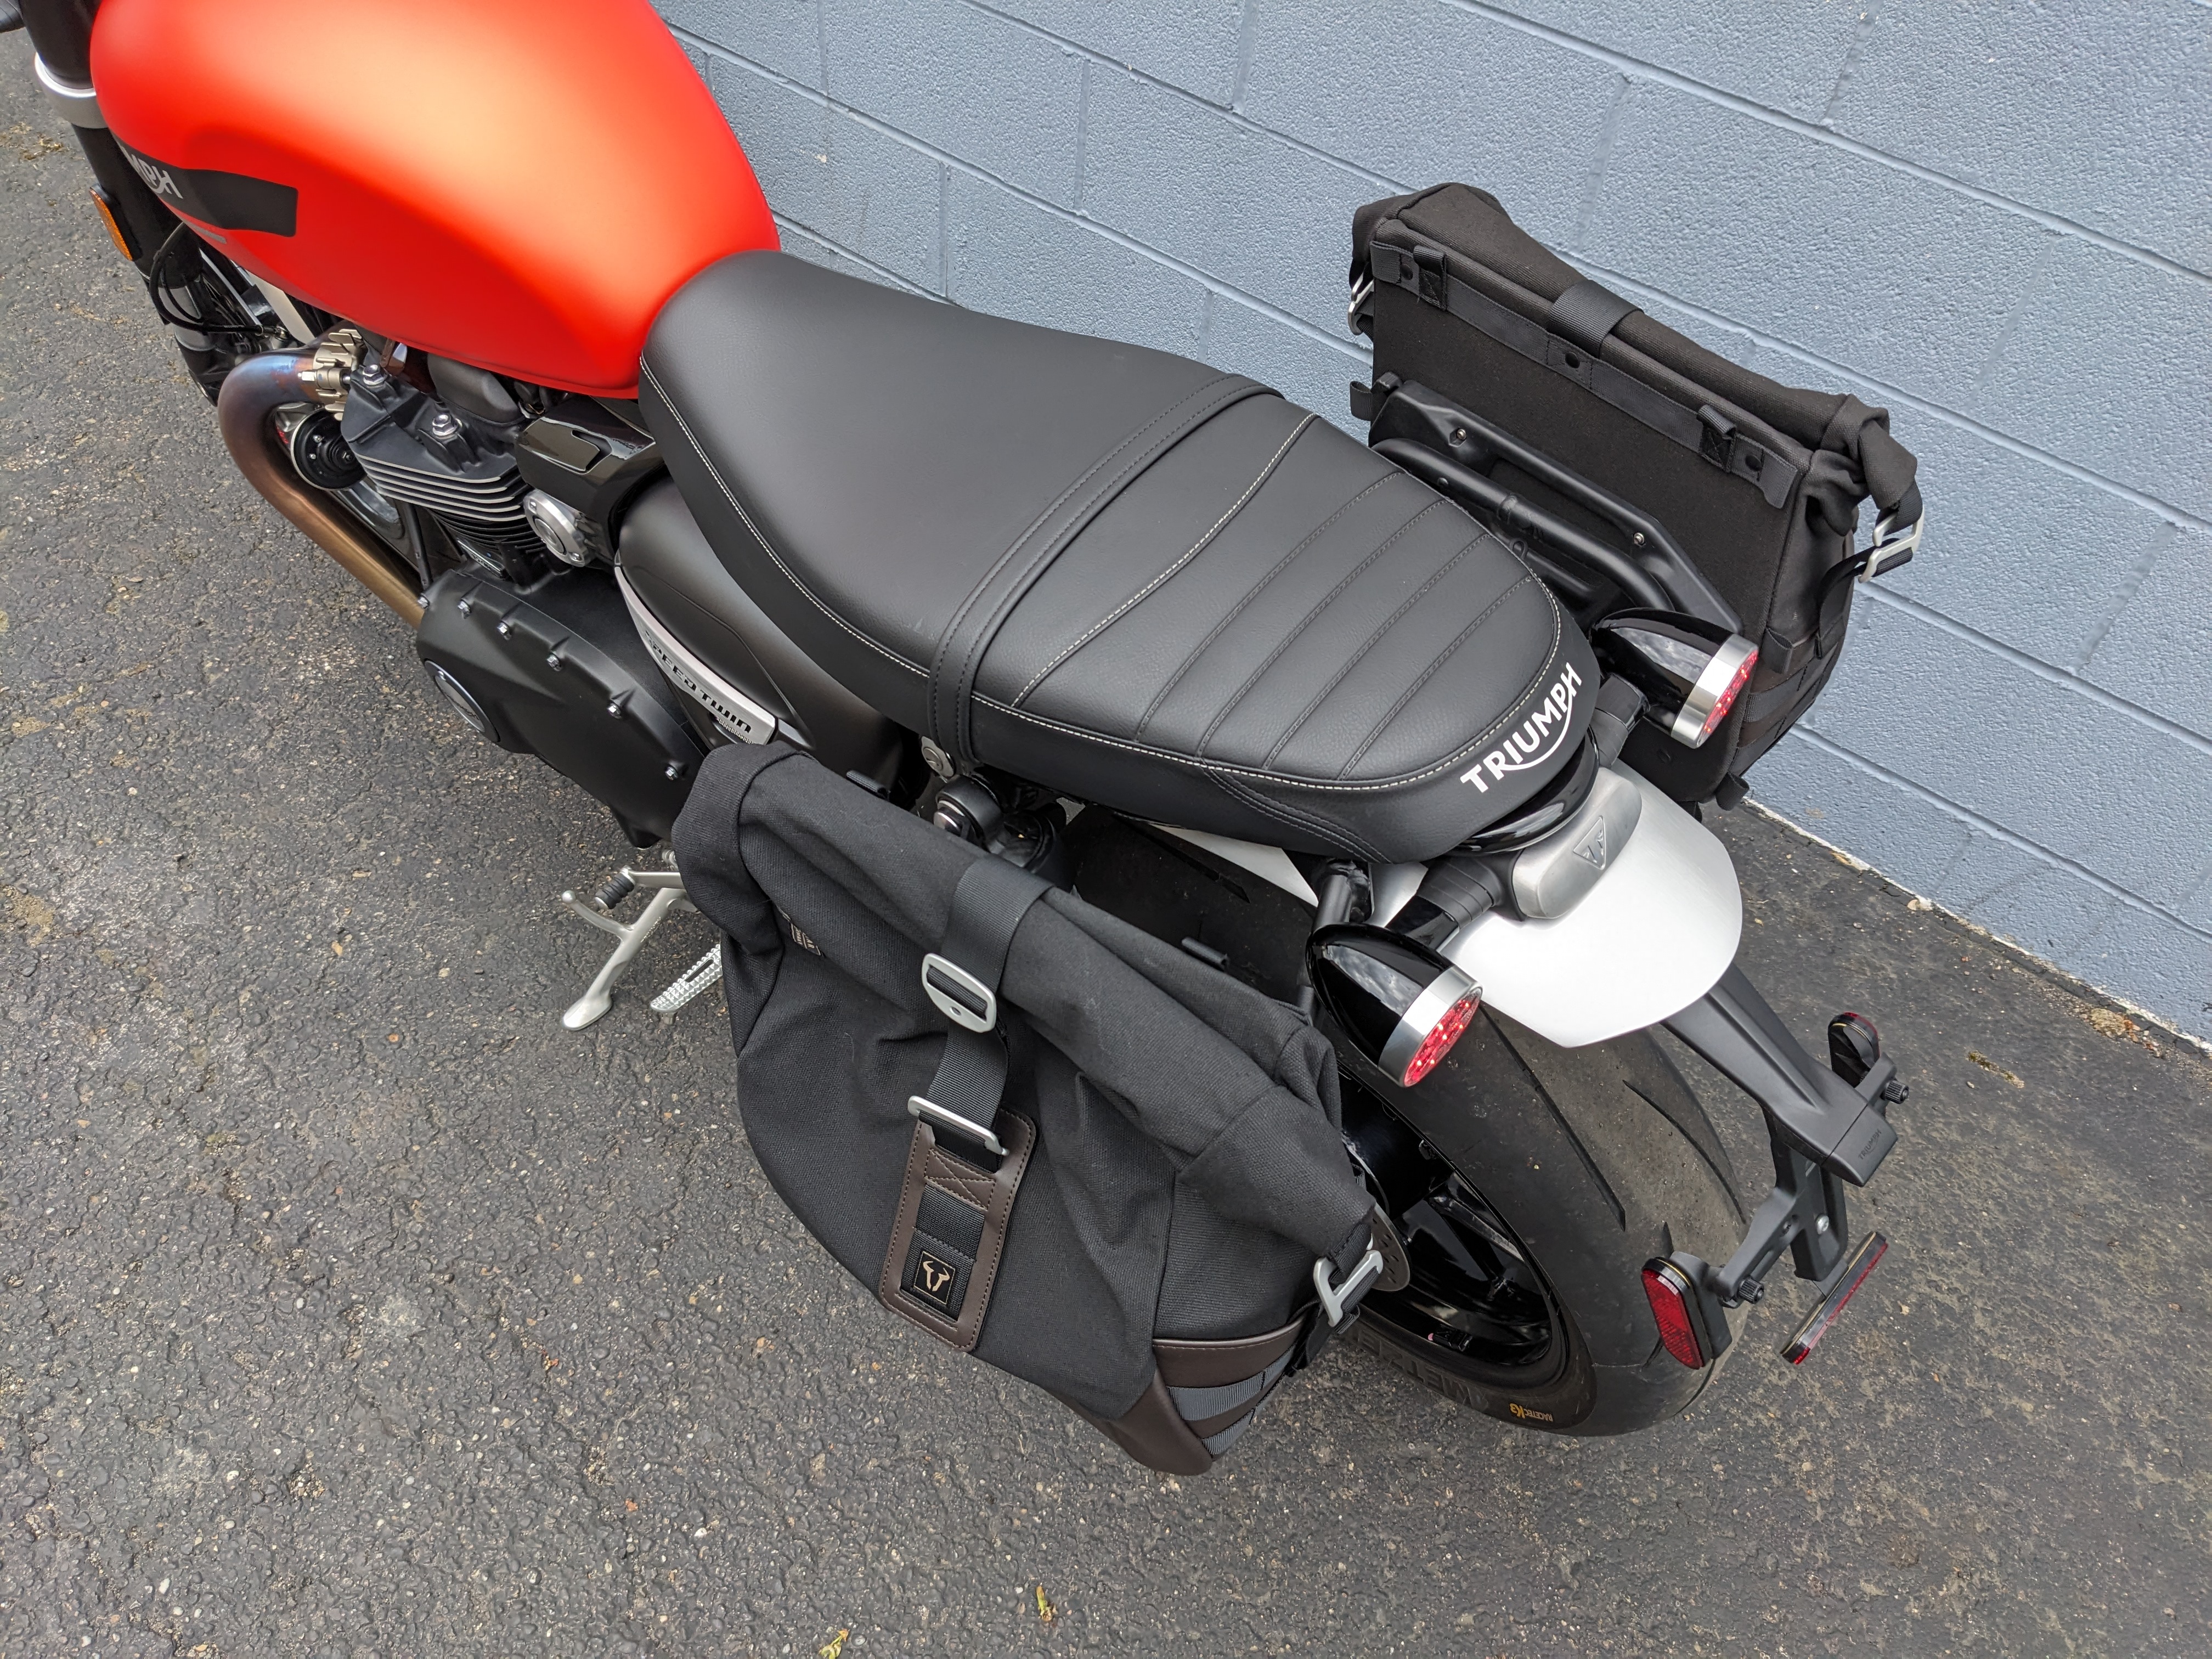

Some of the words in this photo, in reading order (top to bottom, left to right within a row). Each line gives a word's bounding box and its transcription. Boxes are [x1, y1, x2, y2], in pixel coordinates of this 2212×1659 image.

[701, 689, 751, 733] TWIN
[1460, 662, 1582, 793] TRIUMPH
[1858, 1128, 1881, 1159] TRIUMPH
